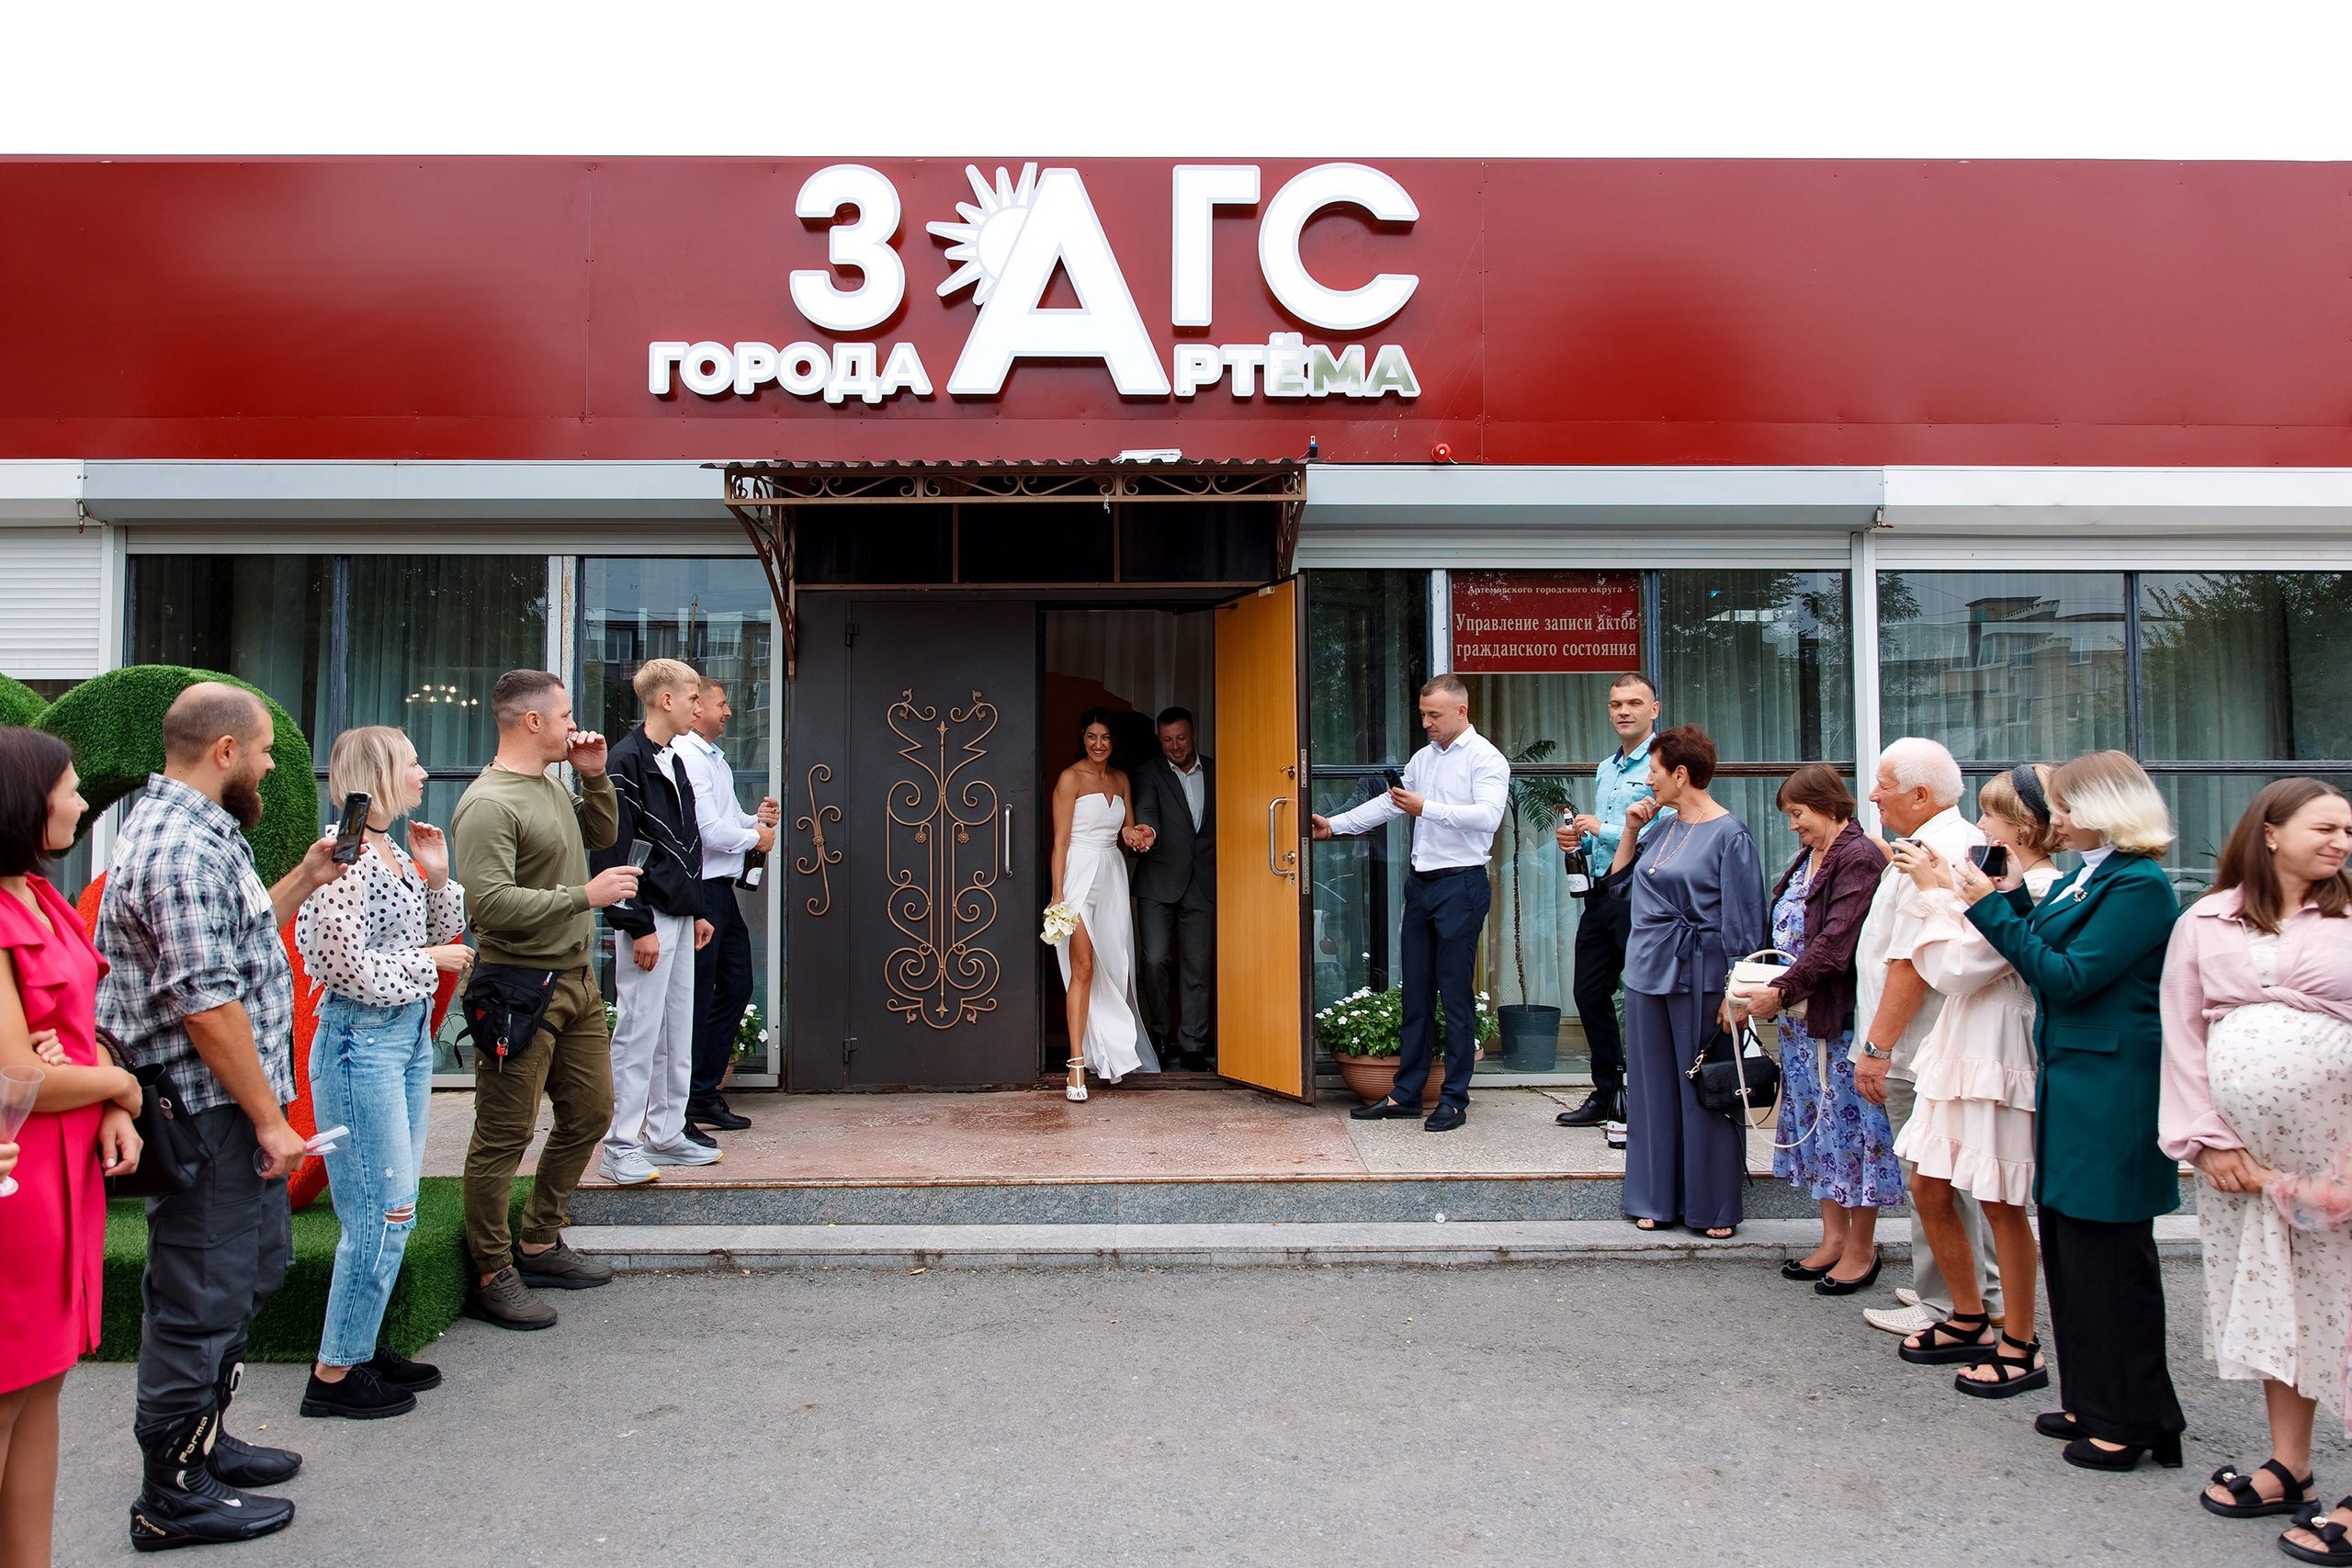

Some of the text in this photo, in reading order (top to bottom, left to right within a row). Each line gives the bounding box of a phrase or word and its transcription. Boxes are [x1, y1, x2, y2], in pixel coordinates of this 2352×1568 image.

[790, 163, 1419, 396] ЗАГС
[649, 341, 933, 403] ГОРОДА
[1536, 586, 1588, 595] городского
[1590, 586, 1623, 595] округа
[1456, 614, 1636, 636] Управление записи актов
[1456, 643, 1636, 661] гражданского состояния
